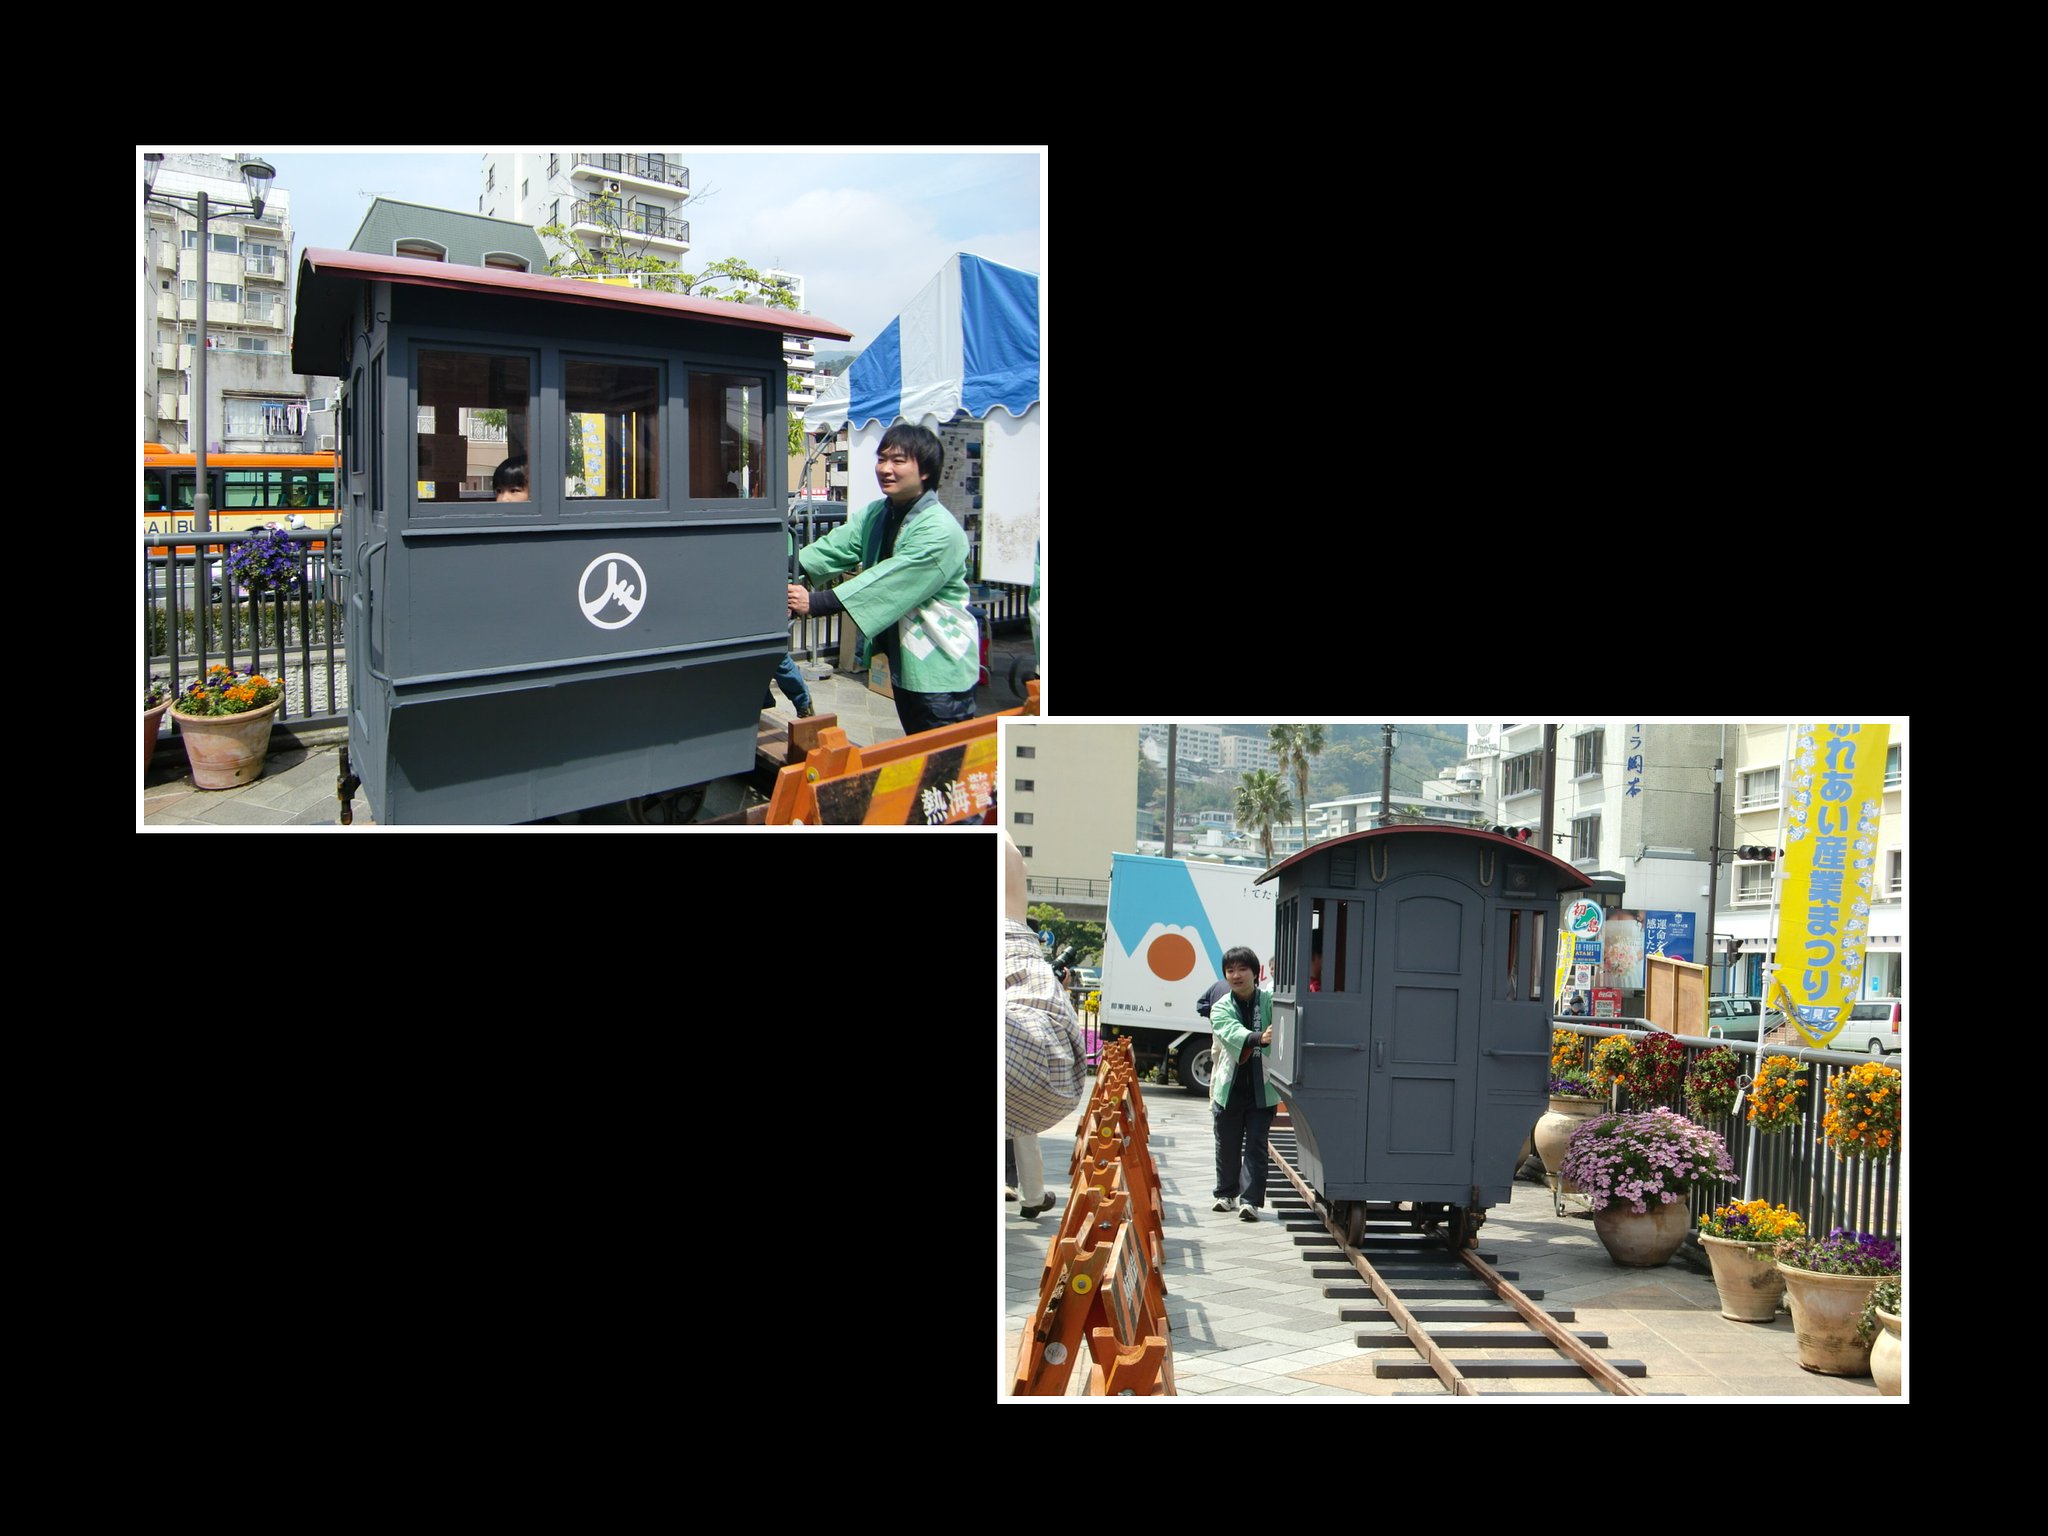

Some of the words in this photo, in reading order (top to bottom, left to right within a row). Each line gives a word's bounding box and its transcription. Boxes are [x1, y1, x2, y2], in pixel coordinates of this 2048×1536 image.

[144, 521, 168, 534] AI
[921, 764, 997, 826] 熱海警
